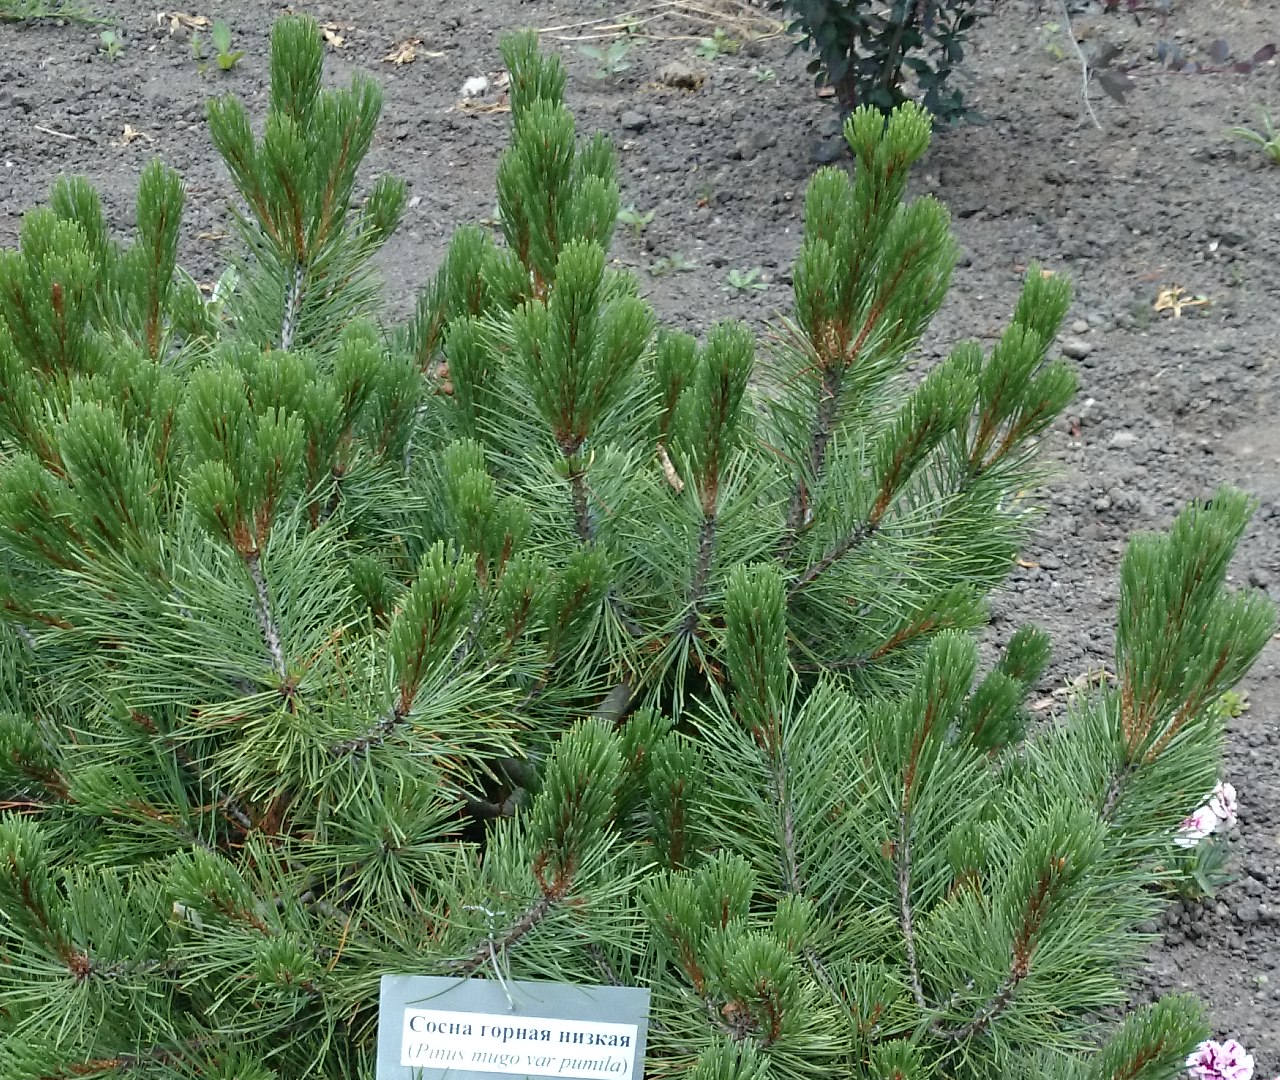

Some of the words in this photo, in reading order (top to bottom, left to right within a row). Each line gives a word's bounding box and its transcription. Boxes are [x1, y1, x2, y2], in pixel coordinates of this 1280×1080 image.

[408, 1014, 472, 1036] Сосна
[481, 1025, 551, 1043] горная
[559, 1031, 631, 1048] низкая
[471, 1049, 521, 1069] mugo
[527, 1054, 556, 1068] var
[558, 1055, 629, 1076] pumila)
